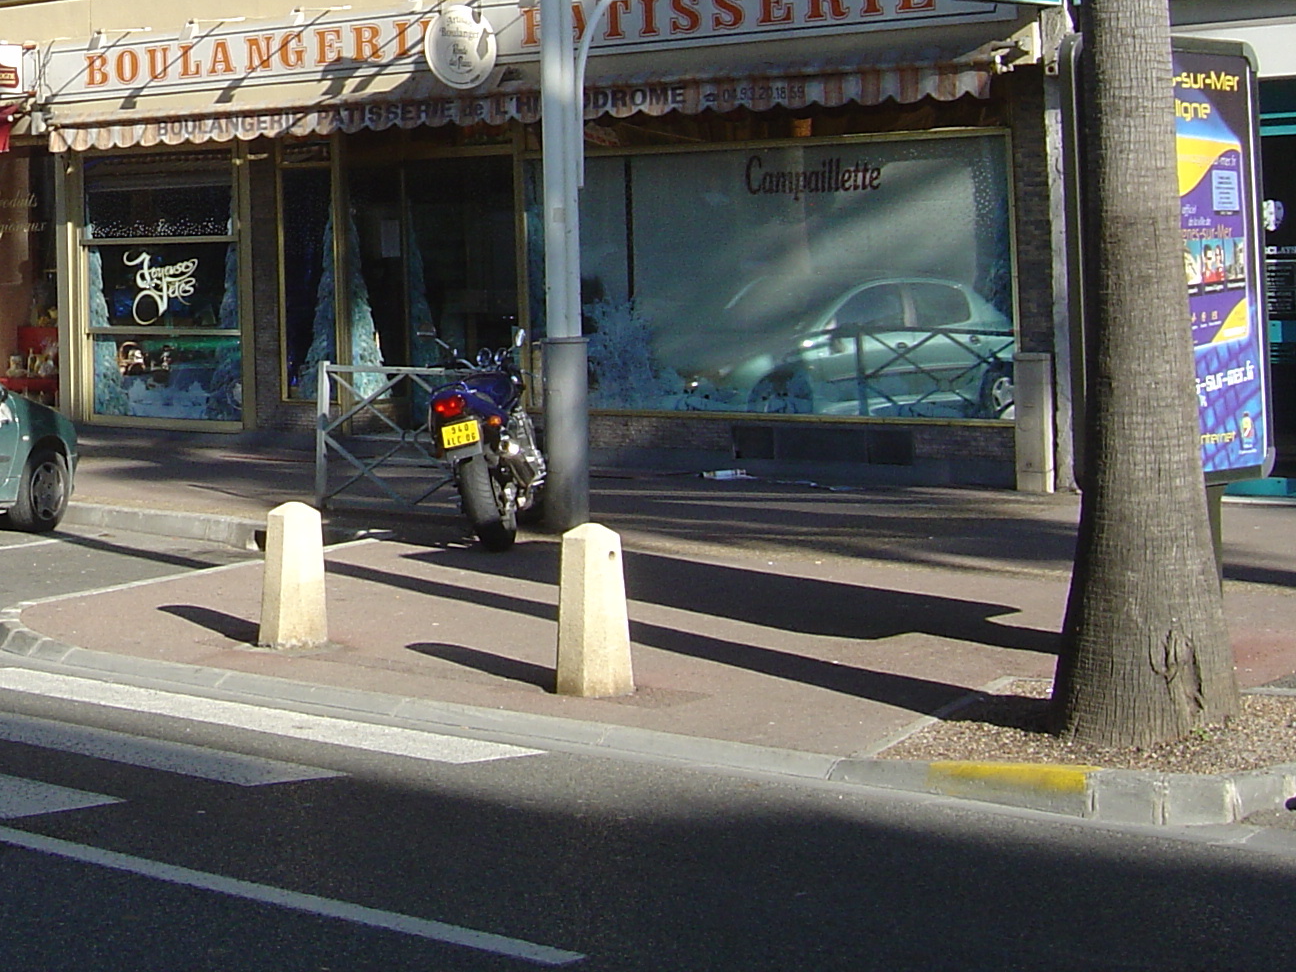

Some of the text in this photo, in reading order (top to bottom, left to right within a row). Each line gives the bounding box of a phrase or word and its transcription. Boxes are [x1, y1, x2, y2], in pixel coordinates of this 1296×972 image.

[1172, 71, 1240, 91] -sur-Mer
[157, 111, 305, 137] BOULANGERIE
[316, 102, 452, 126] PATISSERIE
[464, 102, 483, 118] de
[495, 85, 686, 116] L'HIDROME
[745, 155, 882, 201] Campaillette
